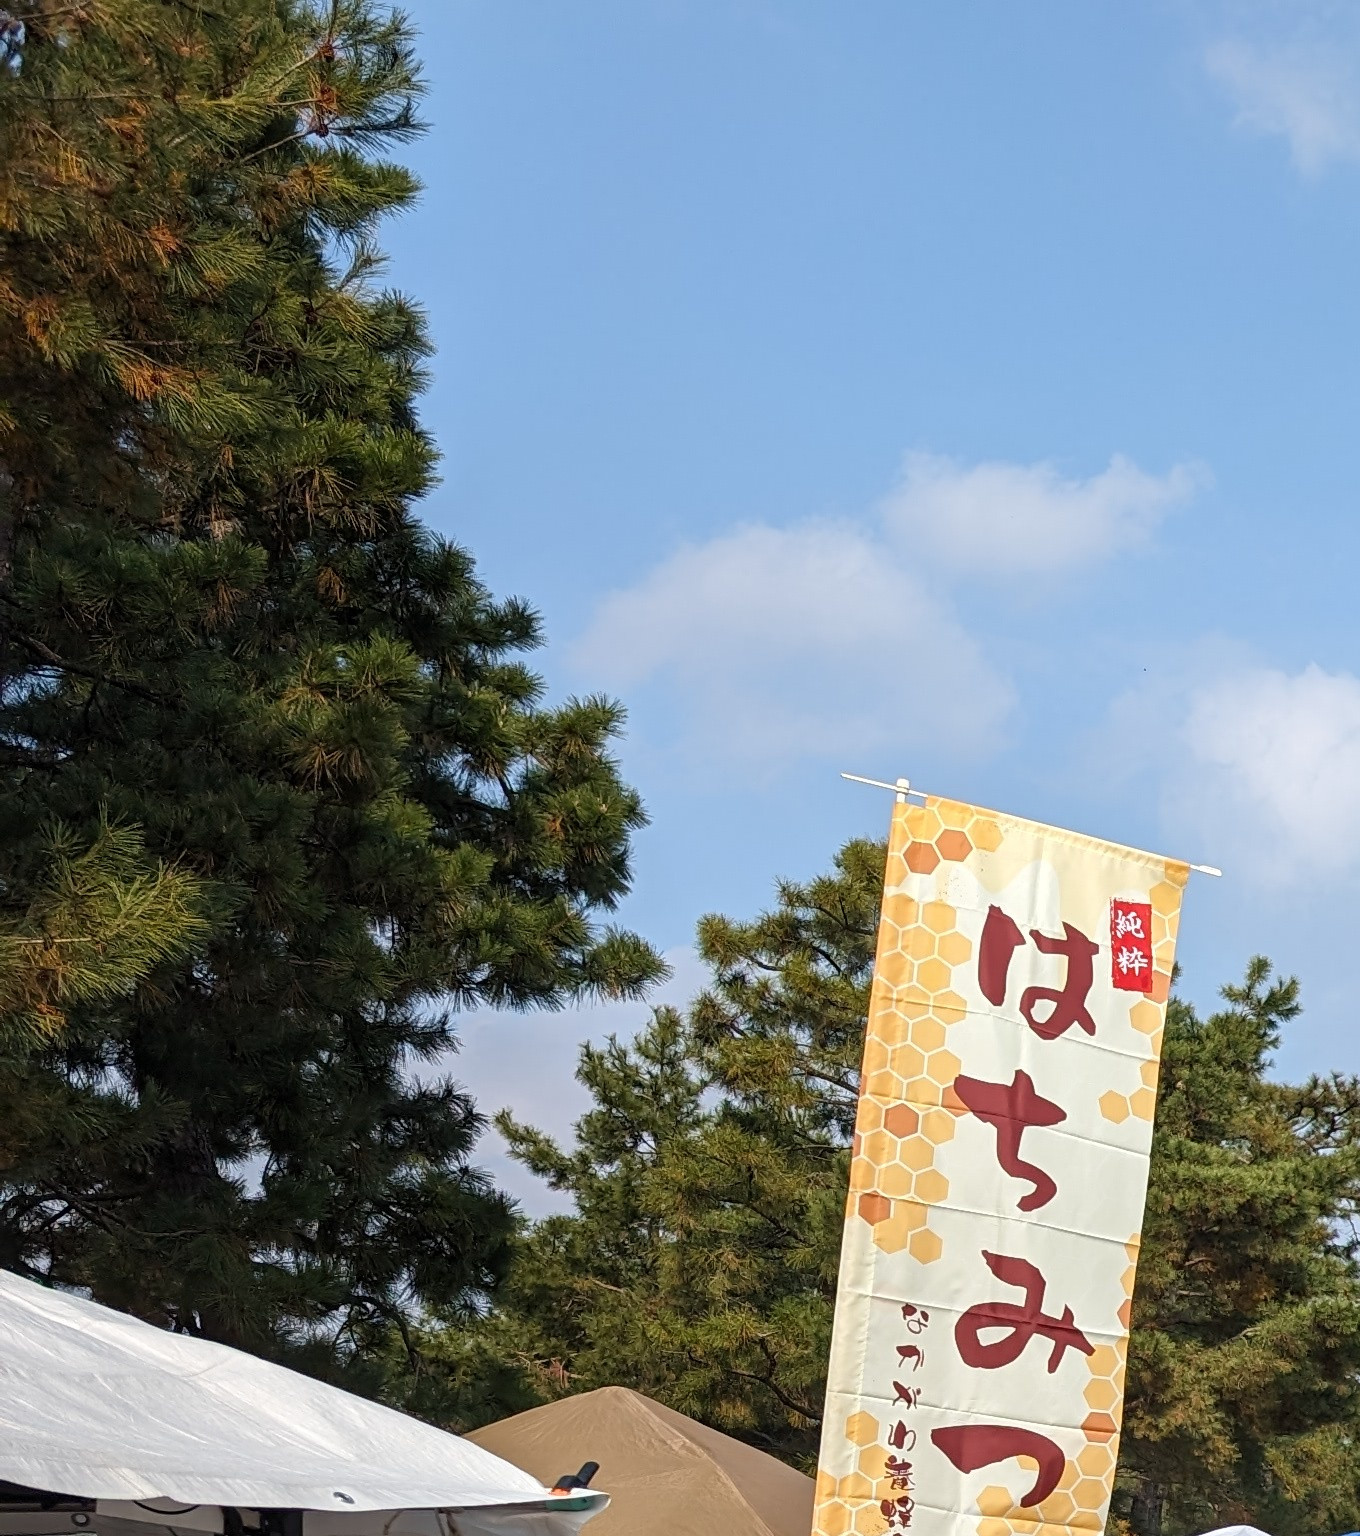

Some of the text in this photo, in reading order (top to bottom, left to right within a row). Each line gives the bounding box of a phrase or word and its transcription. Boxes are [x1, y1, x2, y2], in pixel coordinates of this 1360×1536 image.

[1114, 910, 1147, 977] 純粋
[931, 904, 1099, 1509] はちみつ
